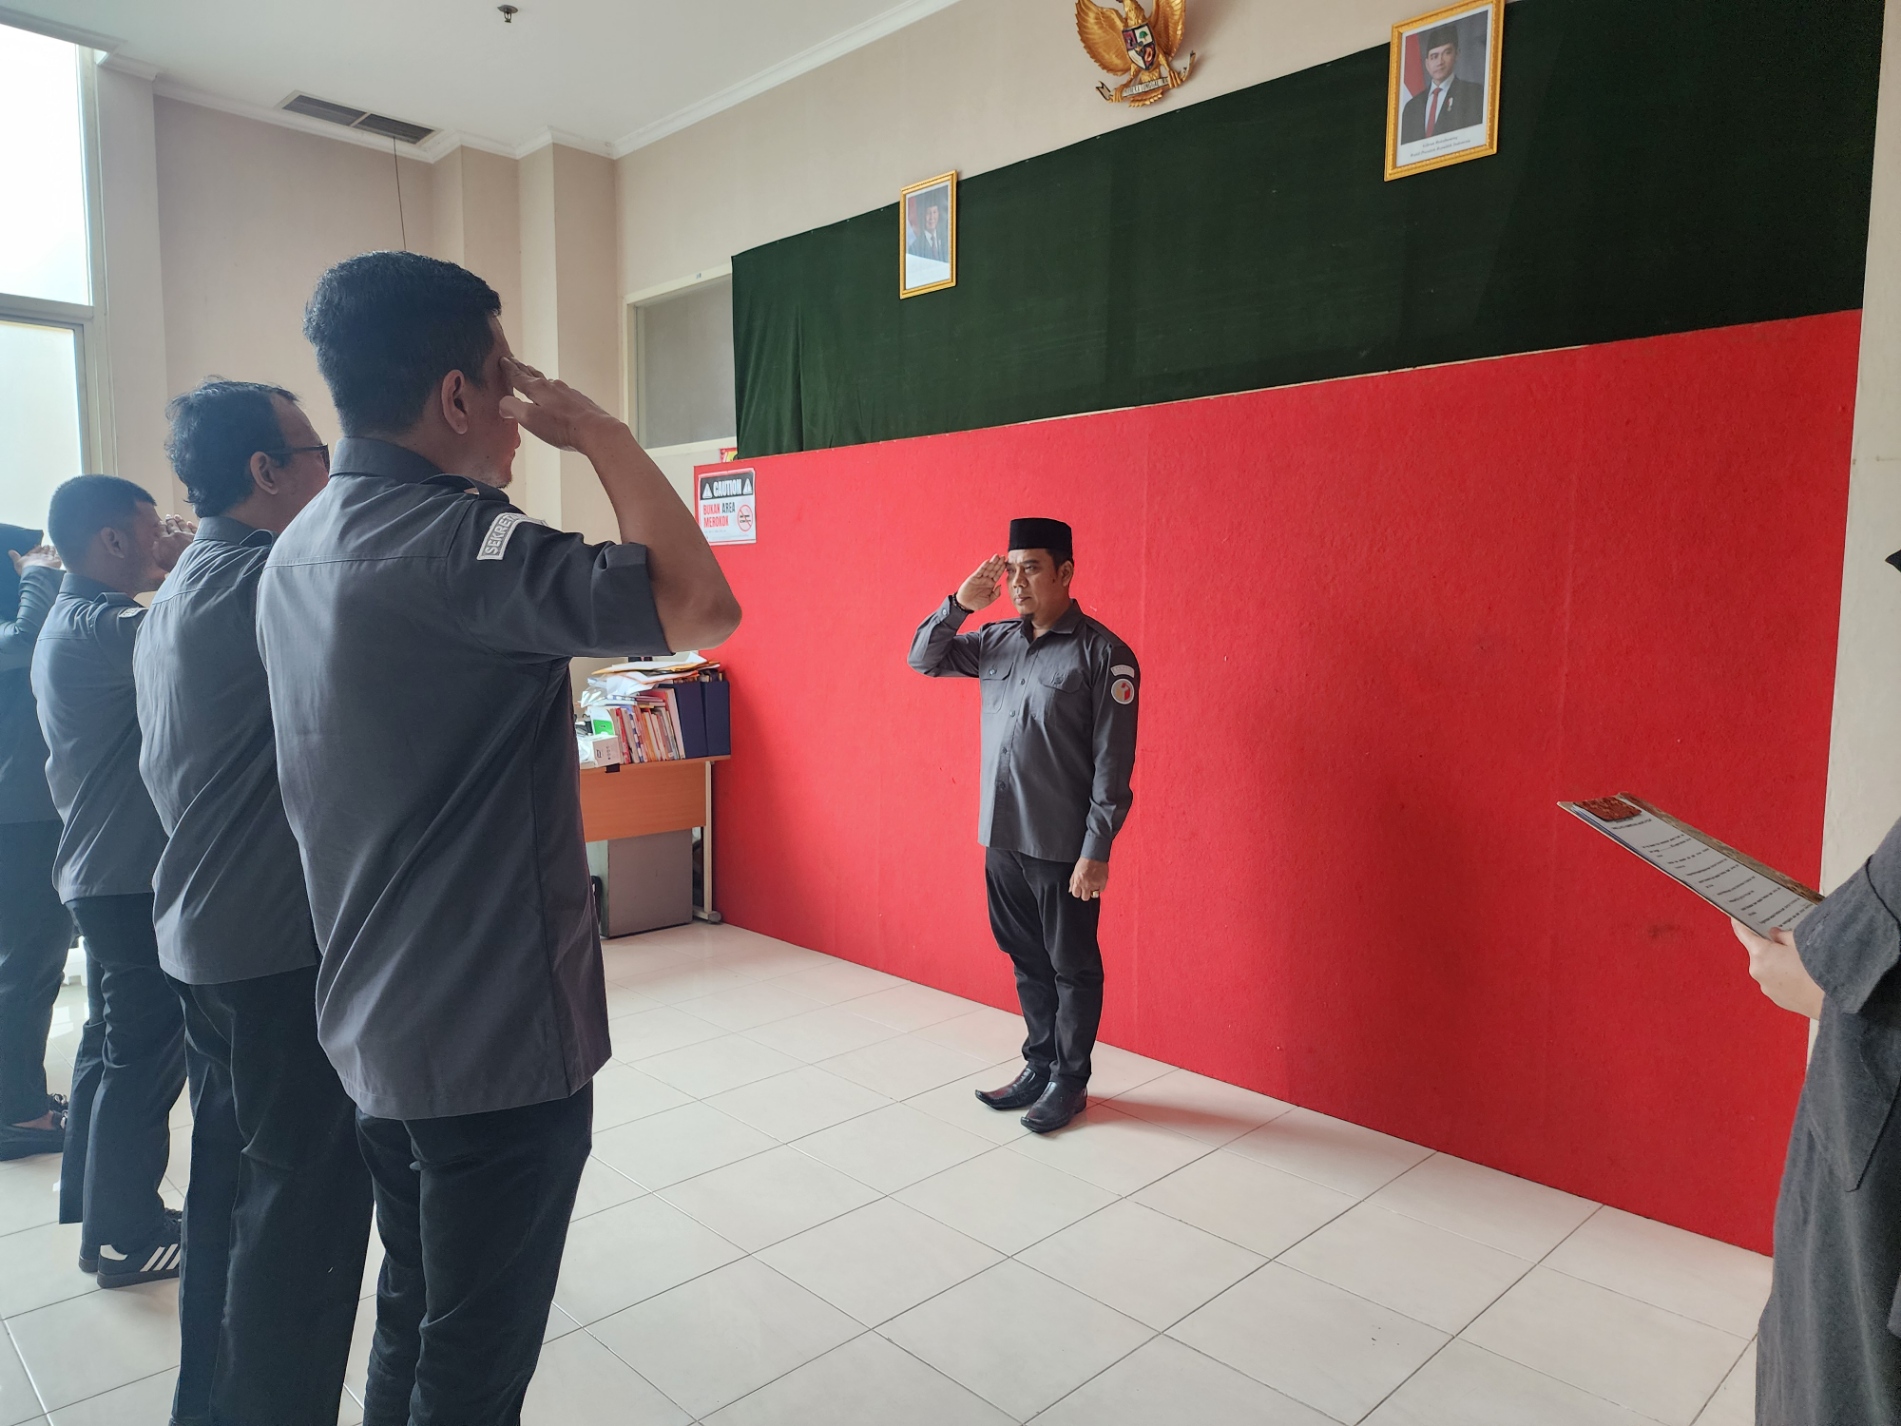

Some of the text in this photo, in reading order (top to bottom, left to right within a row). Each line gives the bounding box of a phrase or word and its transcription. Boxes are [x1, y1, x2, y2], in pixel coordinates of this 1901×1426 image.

[713, 479, 742, 497] CAUTION
[703, 502, 735, 515] BUKAN AREA
[704, 516, 729, 528] MEROKOK
[485, 513, 518, 554] SEKRET
